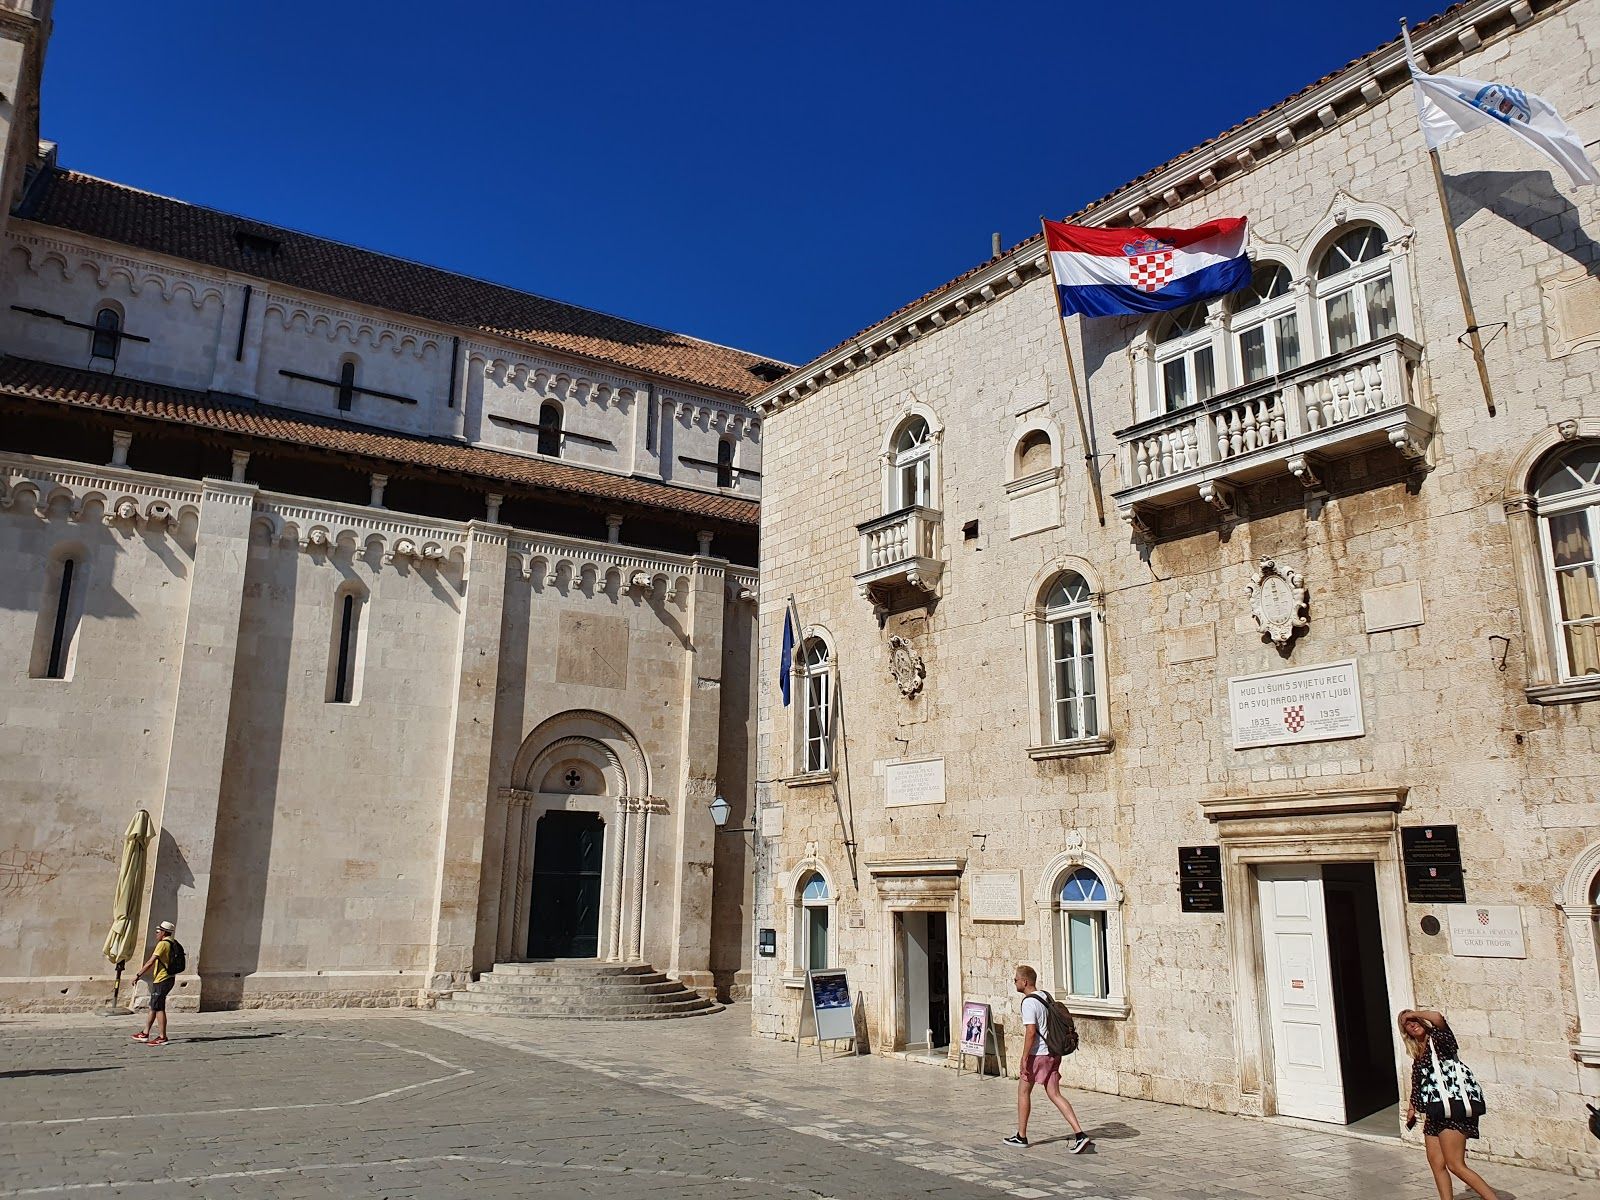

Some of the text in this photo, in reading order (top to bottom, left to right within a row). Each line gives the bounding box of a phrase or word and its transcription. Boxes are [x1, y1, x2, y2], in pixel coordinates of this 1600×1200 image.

[1257, 686, 1266, 695] LI
[1292, 677, 1325, 689] SVIJETU
[1327, 674, 1347, 685] RECI
[1239, 687, 1352, 710] DA SVOJ NAROD HRVAT LJUBI
[1320, 708, 1341, 719] 1935
[1251, 717, 1271, 727] 1835
[1486, 939, 1512, 948] TROGIR
